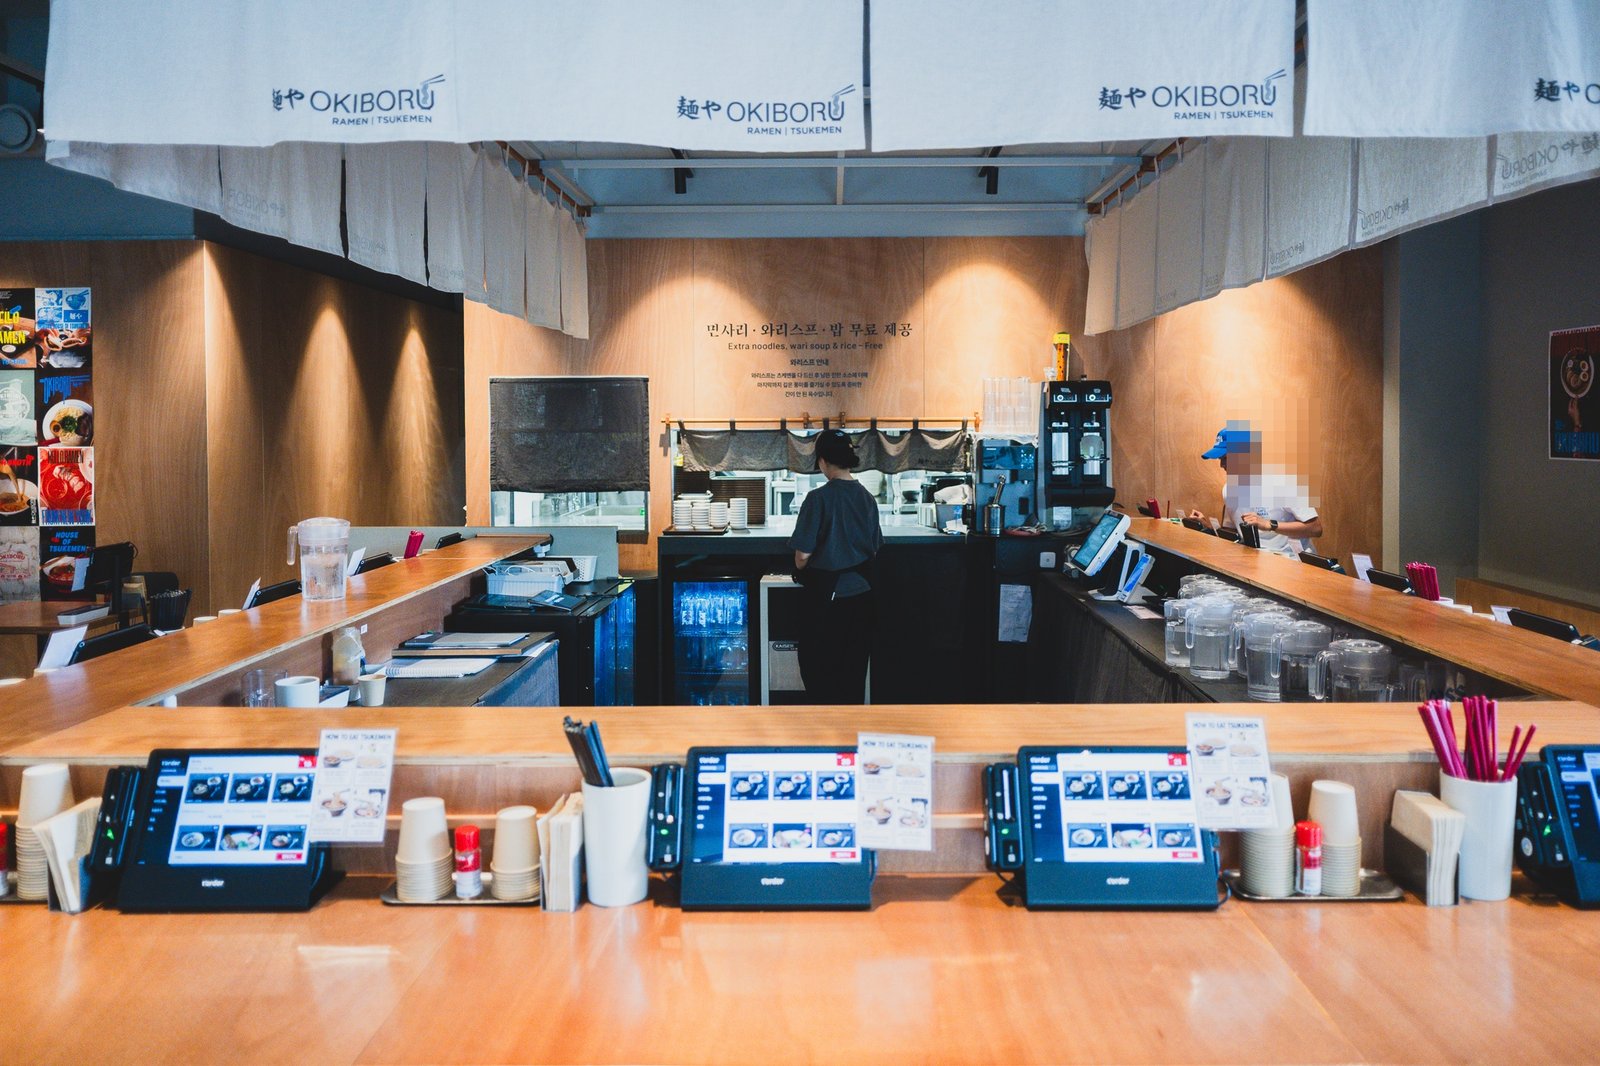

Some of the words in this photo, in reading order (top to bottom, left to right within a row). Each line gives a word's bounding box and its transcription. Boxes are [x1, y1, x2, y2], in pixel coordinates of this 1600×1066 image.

[310, 88, 435, 113] OKIBORU
[1098, 86, 1147, 111] 麺や
[1152, 84, 1277, 108] OKIBORU
[677, 95, 721, 121] 麺や
[727, 99, 846, 123] OKIBORU
[332, 117, 367, 125] RAMEN
[376, 115, 433, 124] TSUKEMEN
[1174, 112, 1211, 120] RAMEN
[1220, 110, 1274, 119] TSUKEMEN
[747, 127, 782, 136] RAMEN
[790, 126, 842, 135] TSUKEMEN
[706, 323, 748, 338] 면사리
[761, 322, 819, 338] 와리스프
[830, 322, 844, 338] 밥
[850, 323, 878, 337] 무료
[884, 322, 913, 338] 제공
[728, 342, 750, 350] Extra
[752, 342, 788, 351] noodles,
[790, 342, 808, 350] wari
[810, 343, 830, 352] soup
[833, 342, 839, 350] &
[840, 342, 856, 350] rice
[865, 342, 883, 350] Free
[790, 358, 815, 367] 와리스프
[816, 358, 829, 367] 안내
[55, 531, 79, 539] HOUSE
[49, 545, 87, 553] TSUKEMEN
